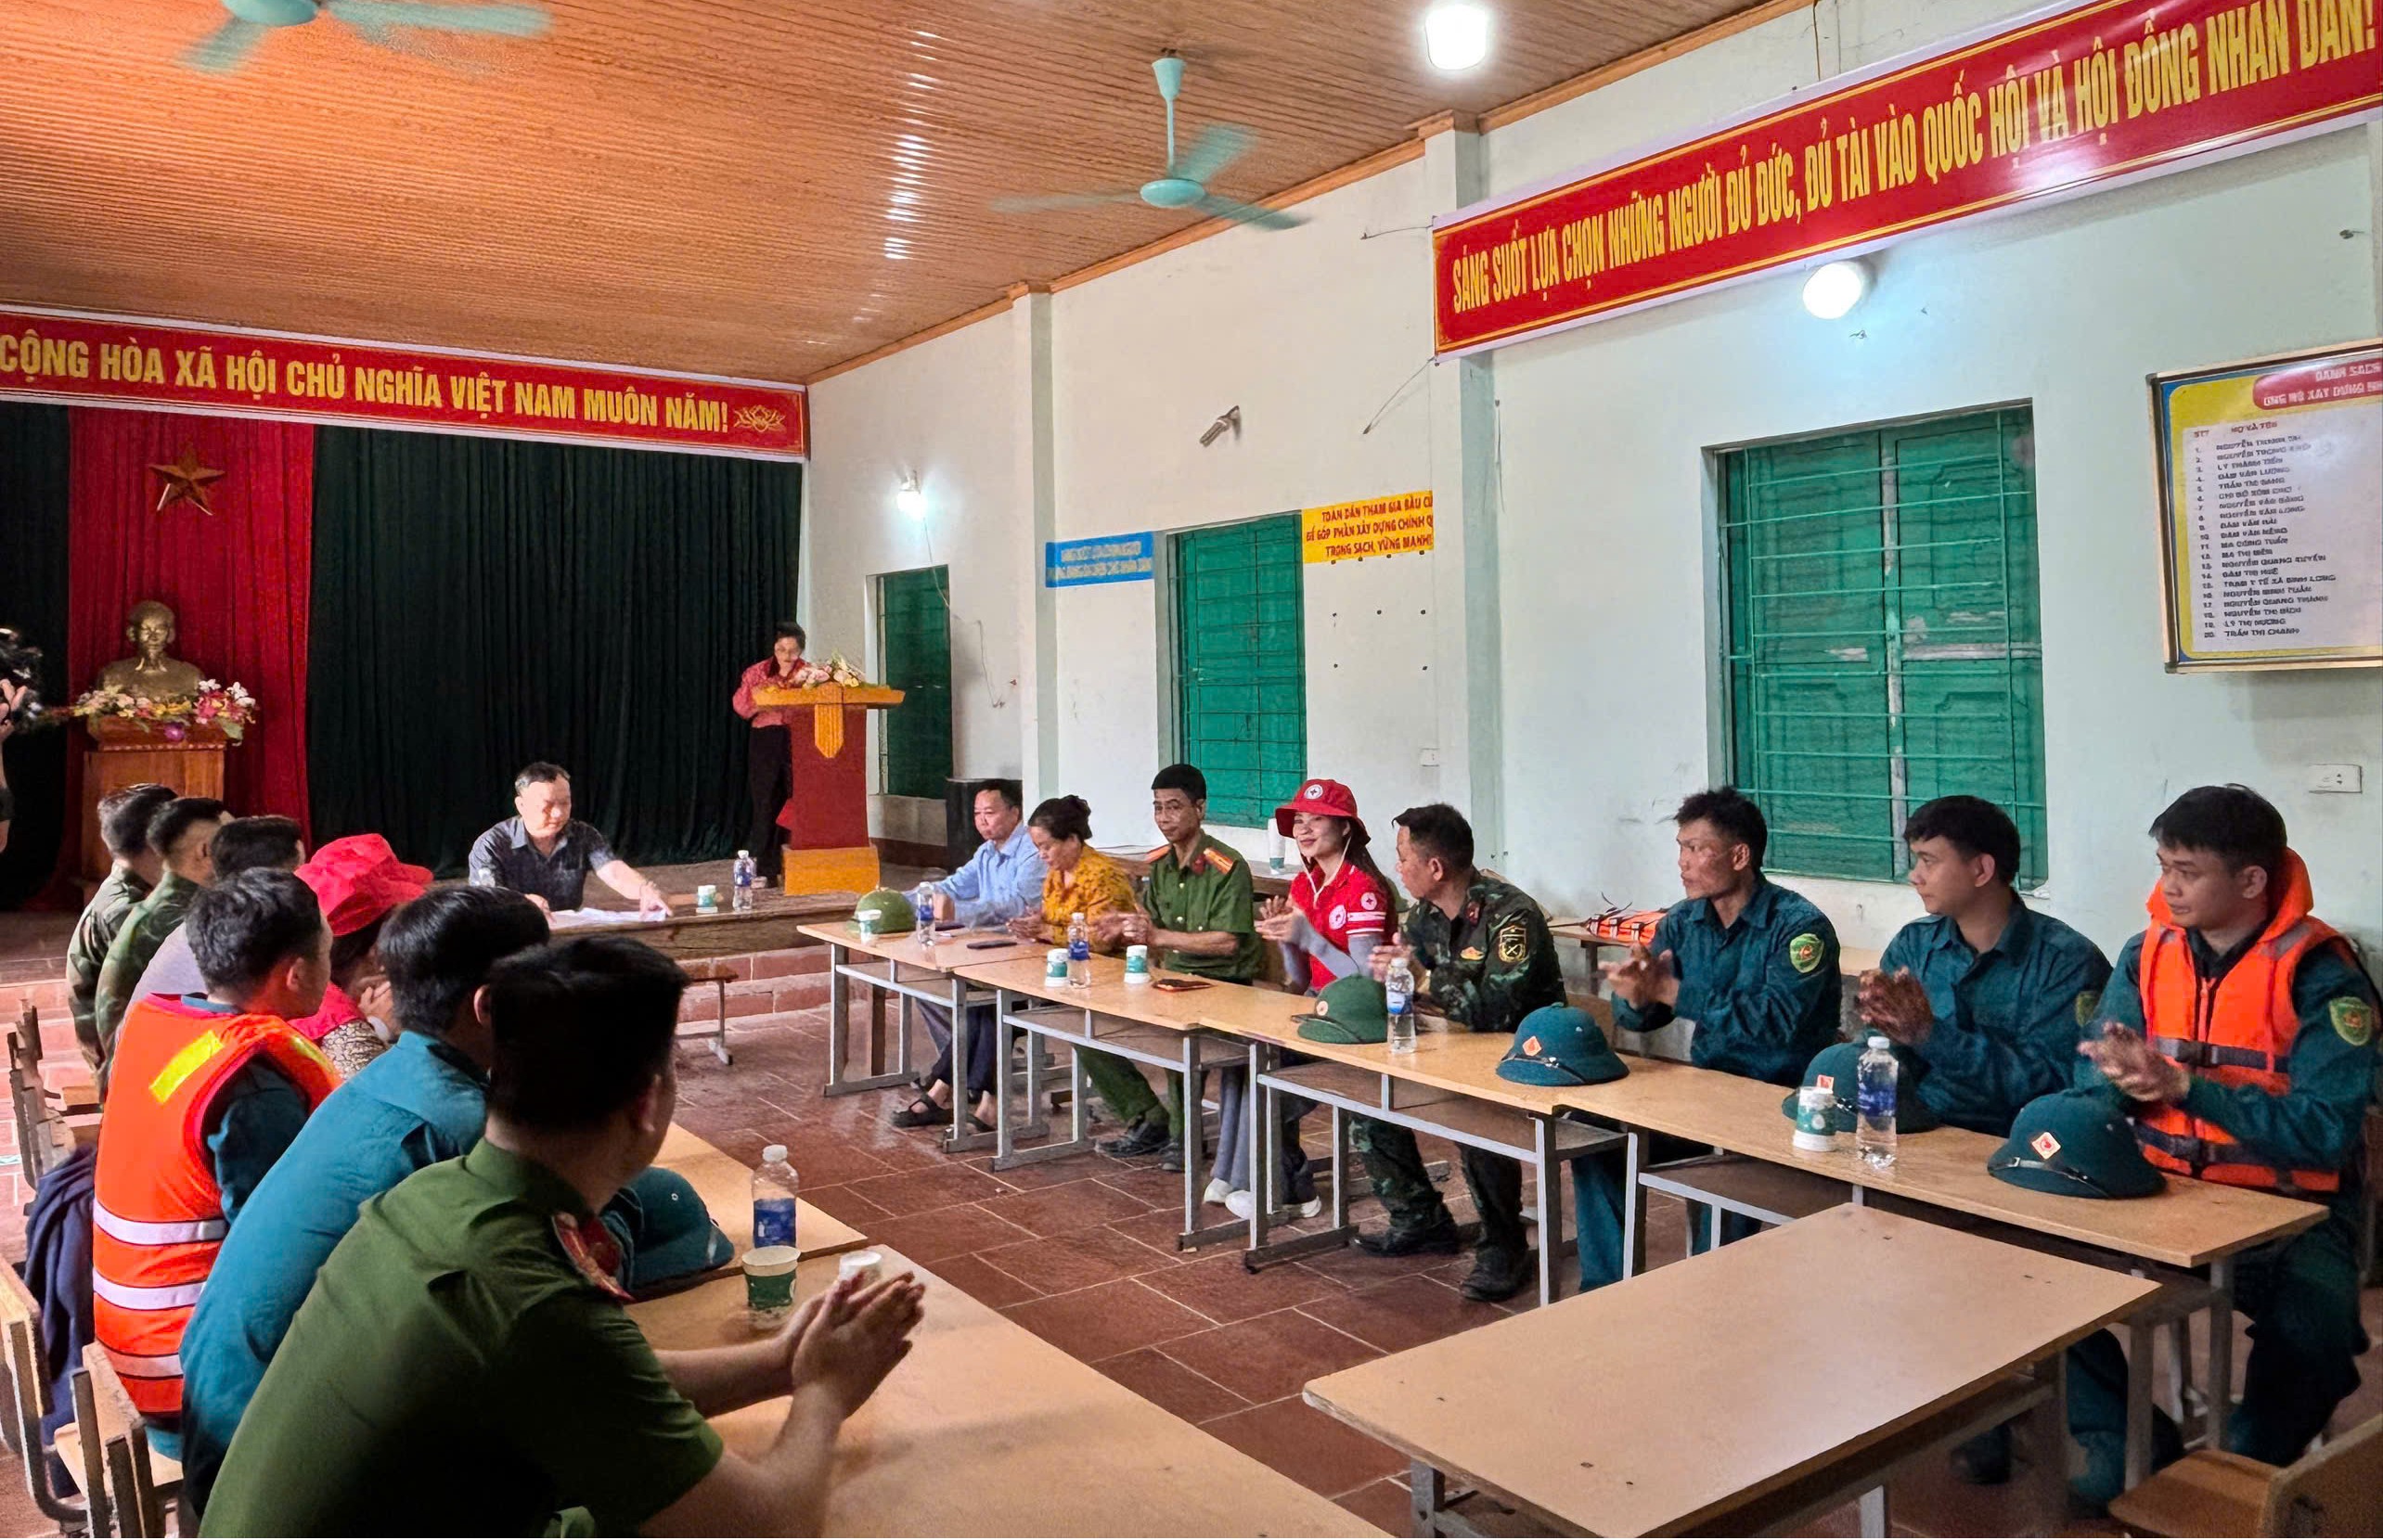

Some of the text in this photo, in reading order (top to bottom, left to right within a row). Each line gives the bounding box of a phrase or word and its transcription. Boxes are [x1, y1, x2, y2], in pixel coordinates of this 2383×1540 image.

[1453, 243, 1489, 314] SÁNG
[1492, 219, 1529, 302] SUỐT
[1531, 225, 1560, 302] LỰA
[1562, 213, 1604, 289] CHỌN
[1608, 189, 1665, 264] NHỮNG
[1668, 161, 1722, 251] NGƯỜI
[1727, 145, 1752, 235] ĐỦ
[1755, 142, 1802, 226] ĐỨC,
[1804, 118, 1833, 212] ĐỦ
[1836, 116, 1871, 203] TÀI
[1874, 104, 1917, 192] VÀO
[1923, 69, 1984, 185] QUỐC
[1989, 63, 2030, 169] HỘI
[2034, 49, 2069, 142] VÀ
[2074, 35, 2119, 146] HỘI
[2124, 7, 2201, 119] ĐỒNG
[0, 327, 728, 433] CỘNG HÒA XÃ HỘI CHỦ NGHĨA VIỆT NAM MUÔN NĂM!
